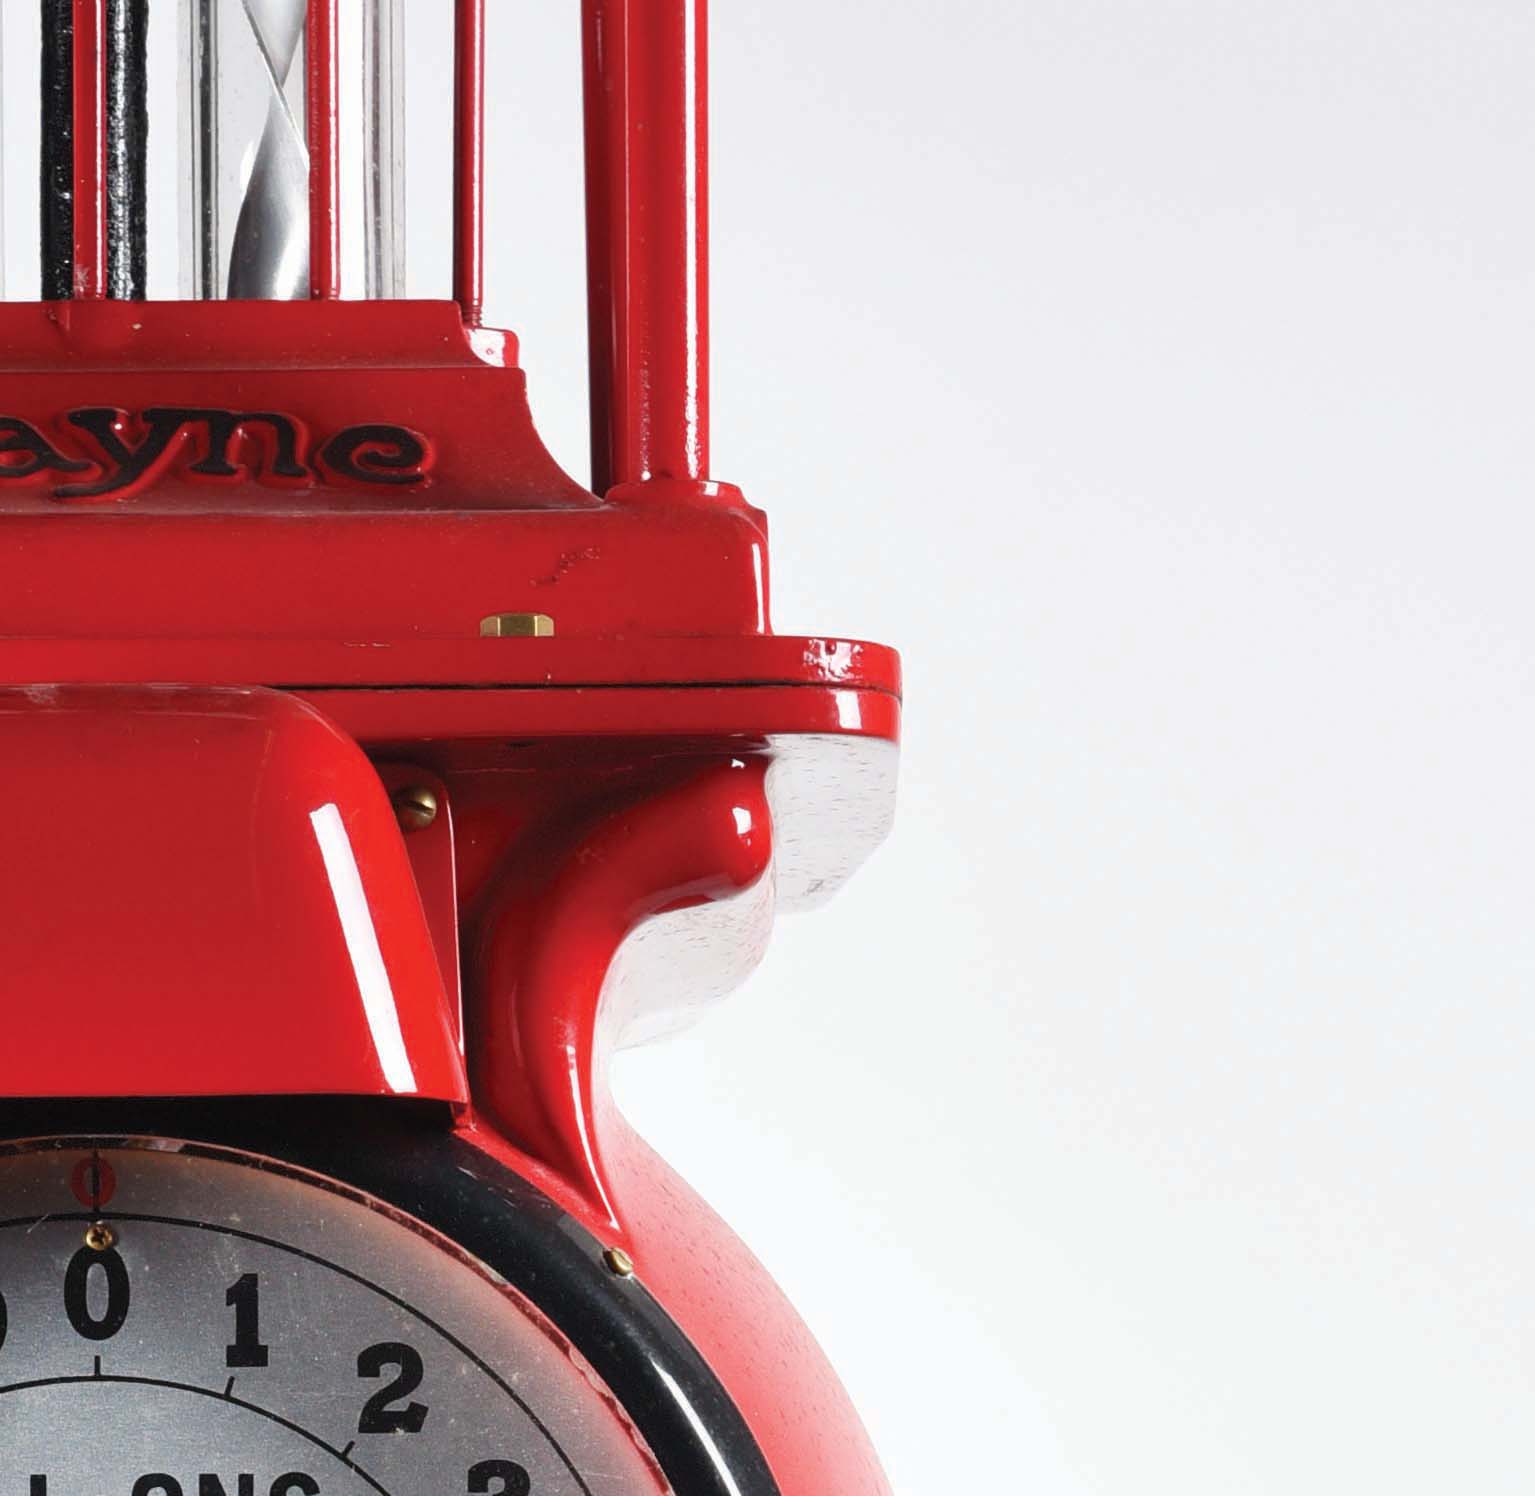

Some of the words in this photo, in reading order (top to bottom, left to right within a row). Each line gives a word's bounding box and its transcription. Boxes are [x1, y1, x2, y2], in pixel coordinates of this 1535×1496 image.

[64, 1245, 132, 1341] 0
[226, 1274, 268, 1367] 1
[357, 1342, 429, 1434] 2
